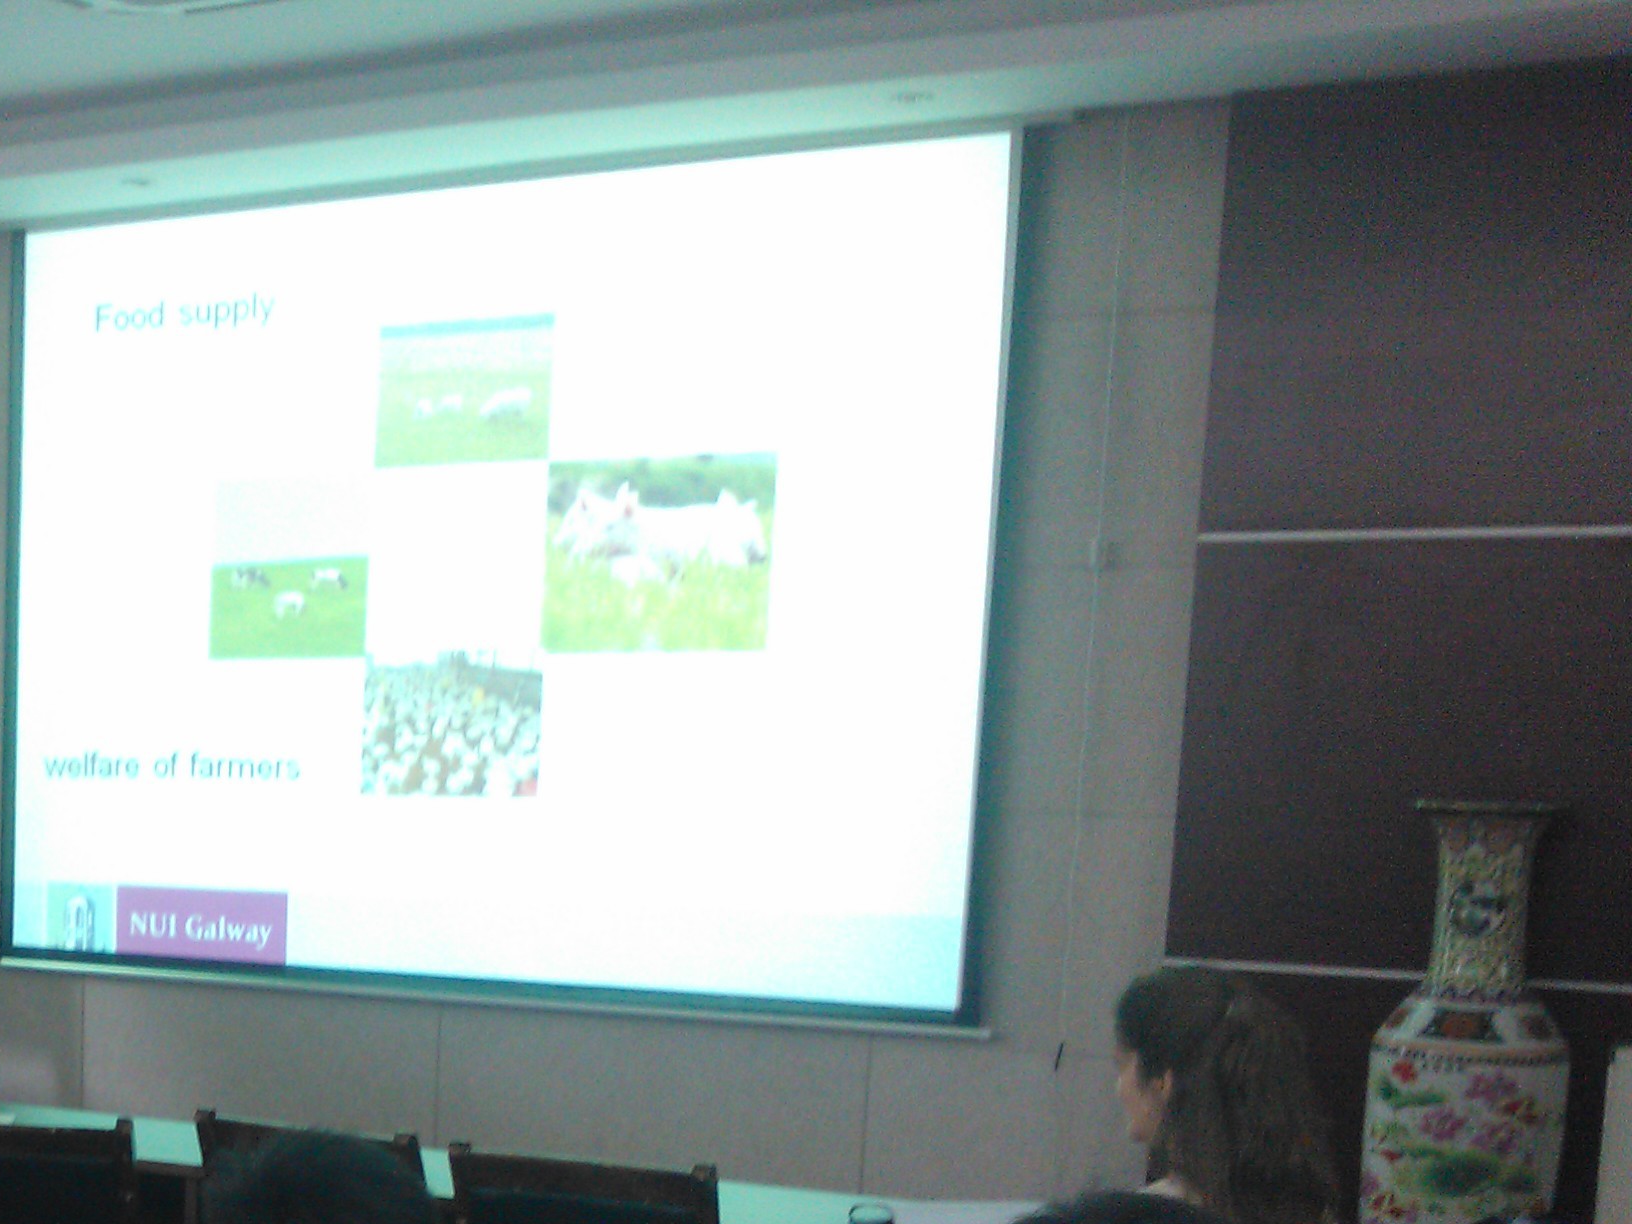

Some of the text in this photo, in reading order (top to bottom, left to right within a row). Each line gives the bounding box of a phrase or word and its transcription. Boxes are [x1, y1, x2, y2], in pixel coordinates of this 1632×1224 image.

[96, 293, 275, 332] Food supply
[45, 750, 301, 780] welfare of farmers
[130, 912, 273, 950] NUI Galway
